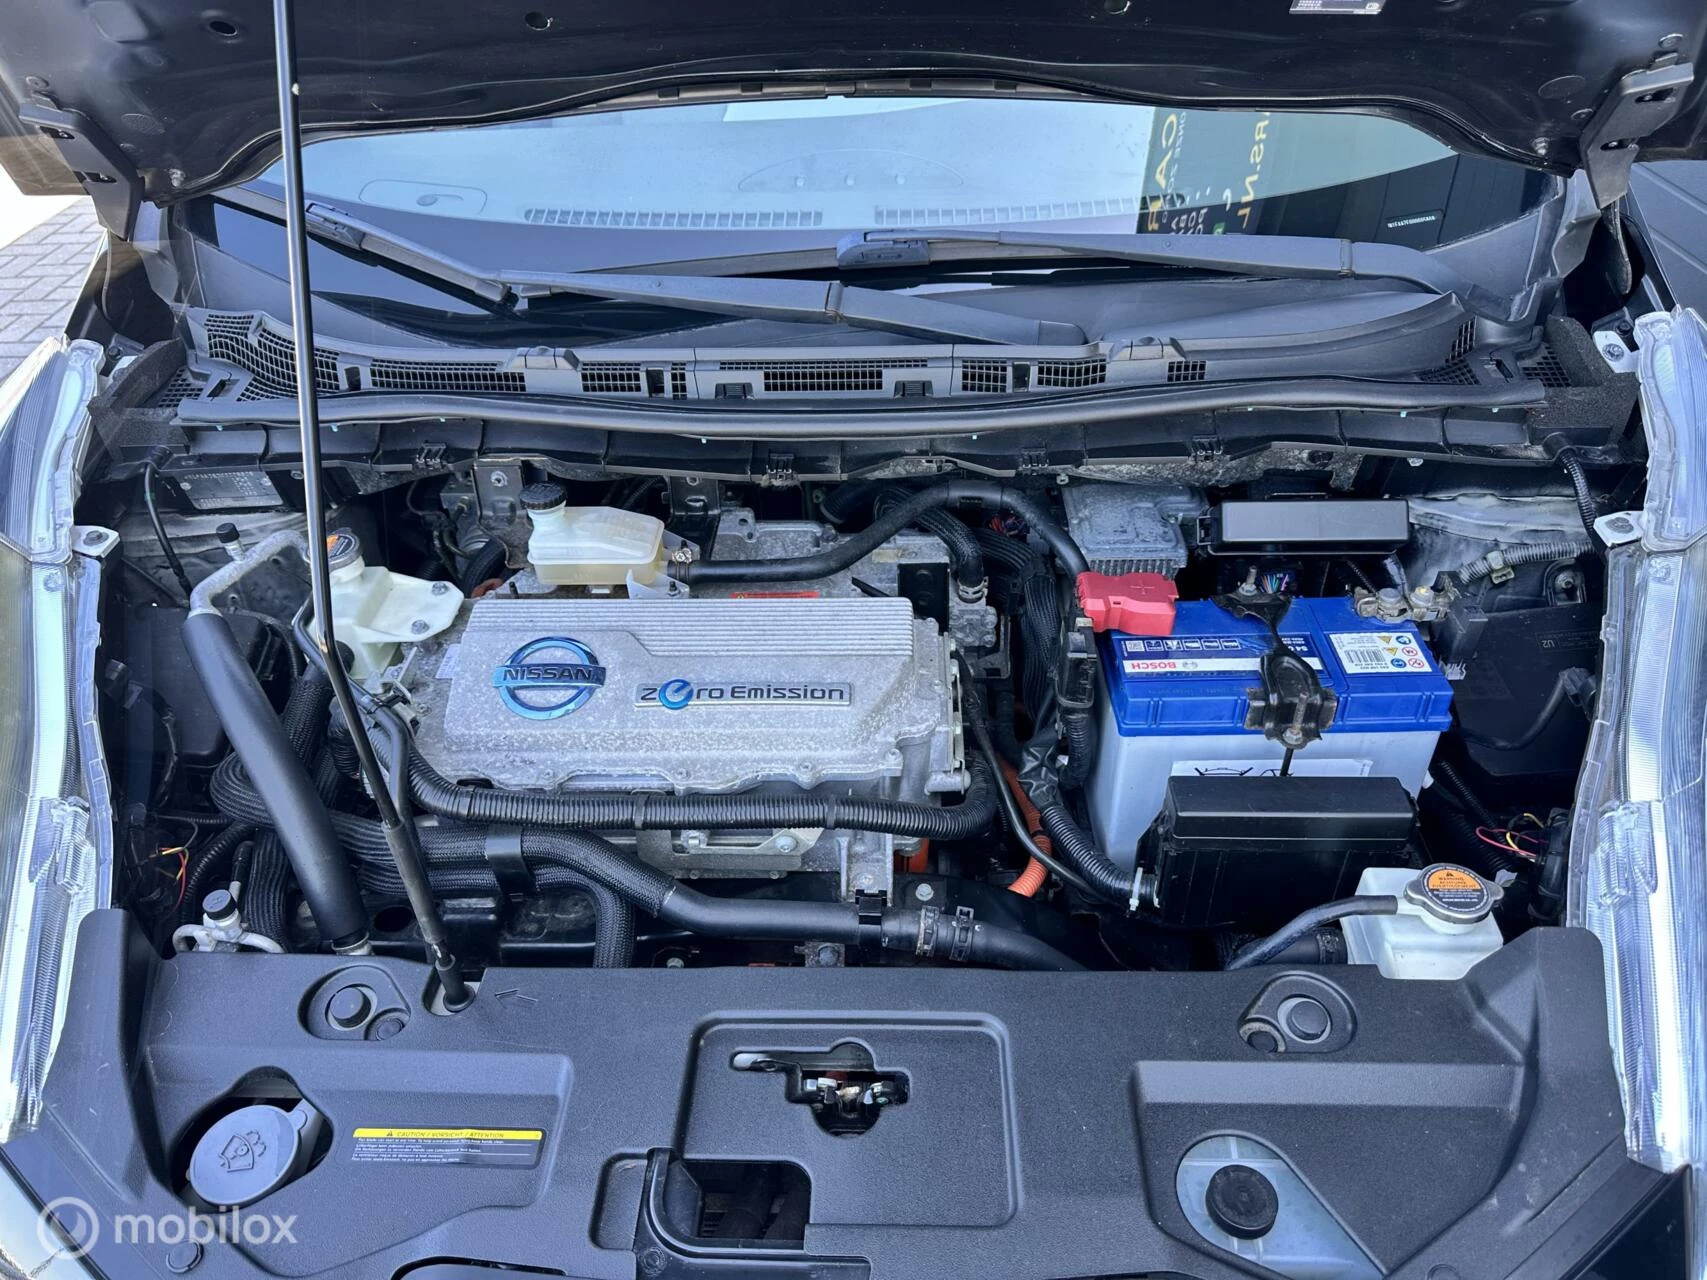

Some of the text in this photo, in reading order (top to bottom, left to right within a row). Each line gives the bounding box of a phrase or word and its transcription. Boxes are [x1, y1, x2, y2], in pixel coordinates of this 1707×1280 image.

[503, 665, 593, 681] NISSAN
[1131, 661, 1177, 670] BOSCH
[730, 684, 845, 701] Emission
